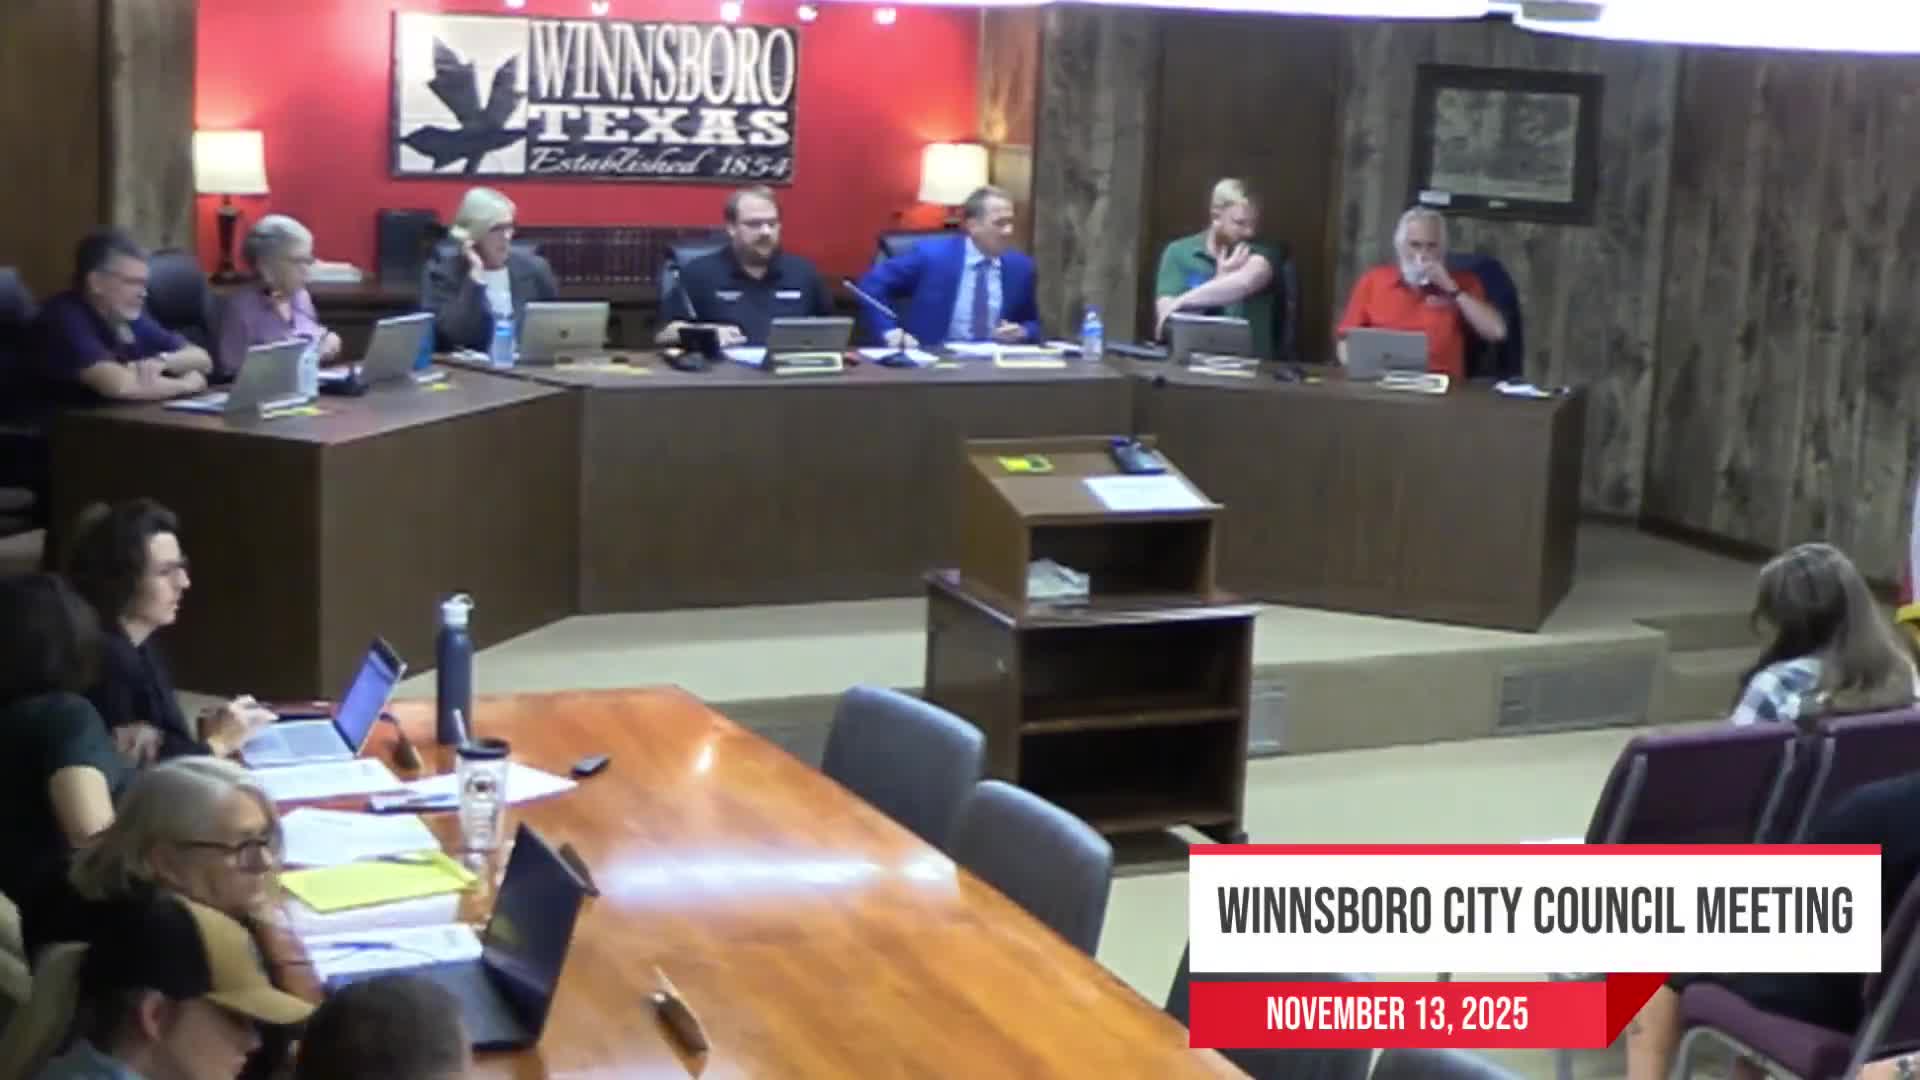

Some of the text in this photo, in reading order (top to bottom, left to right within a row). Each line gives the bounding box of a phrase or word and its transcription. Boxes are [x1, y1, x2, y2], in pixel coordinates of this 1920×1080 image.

[531, 22, 795, 106] WINNSBORO
[529, 104, 790, 145] TEXAS
[530, 148, 790, 177] Established 1854
